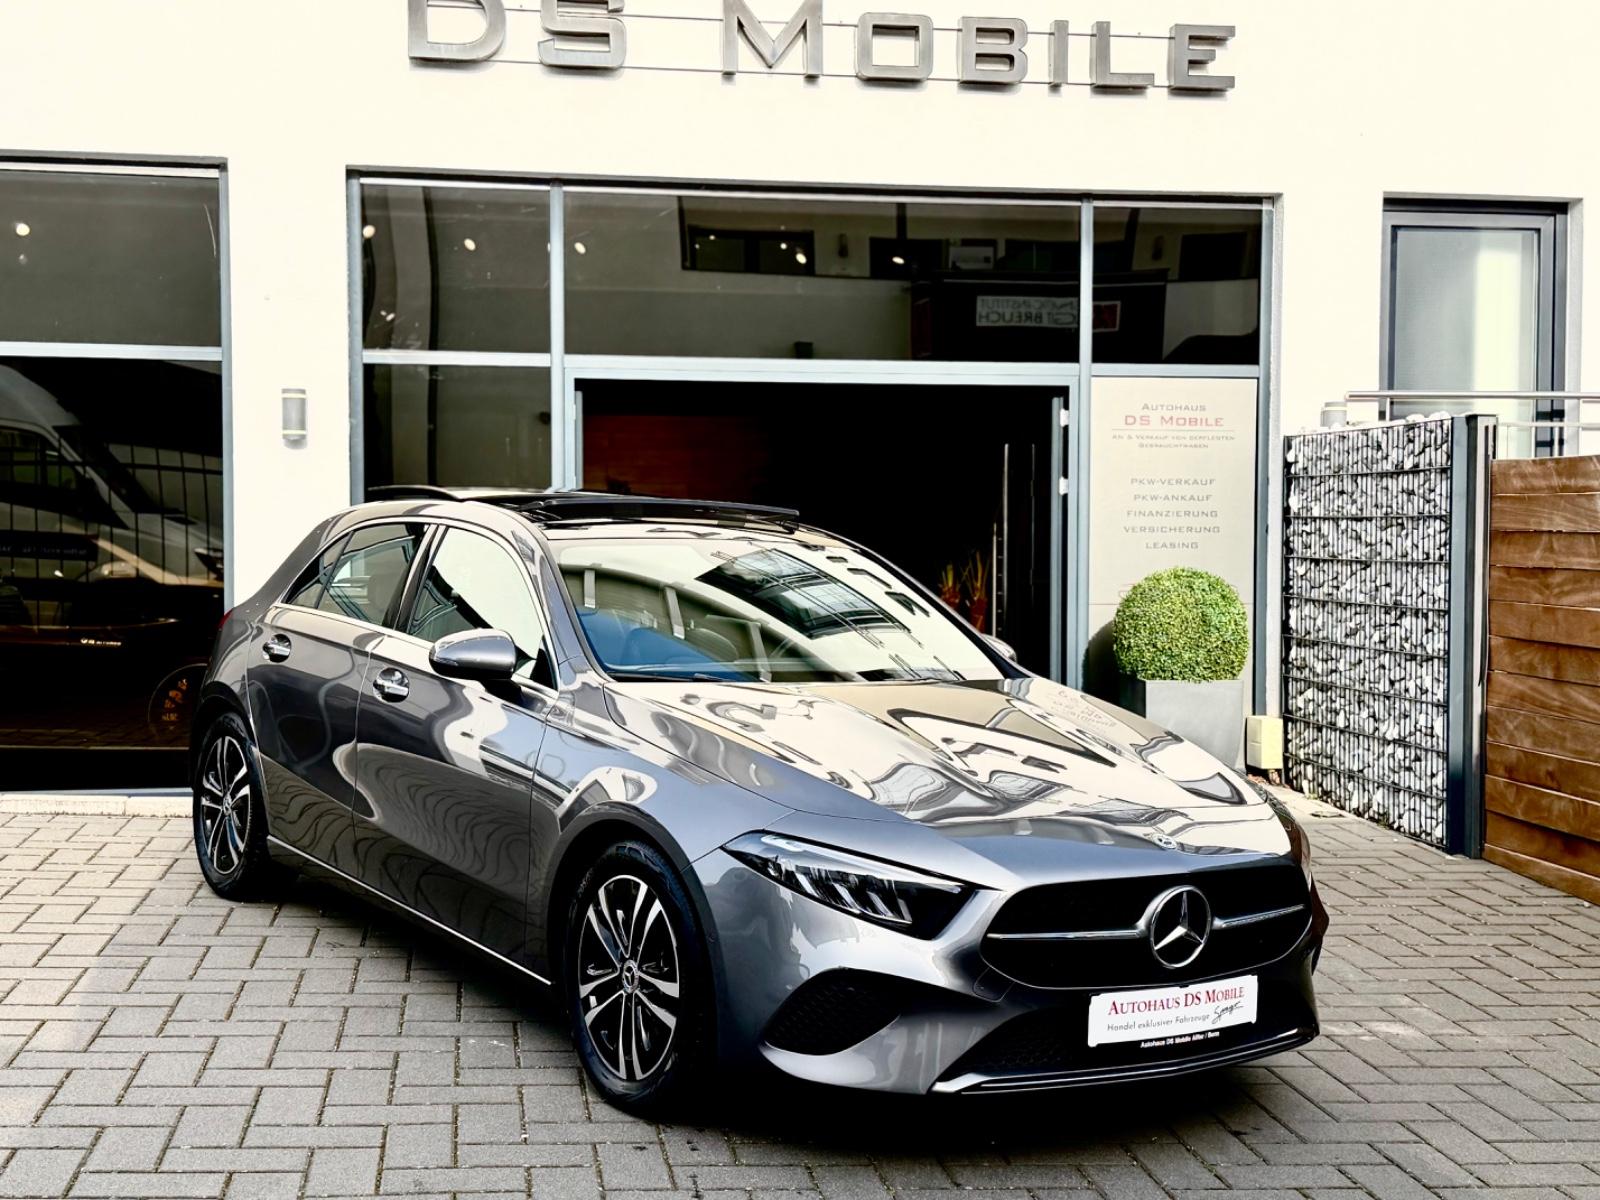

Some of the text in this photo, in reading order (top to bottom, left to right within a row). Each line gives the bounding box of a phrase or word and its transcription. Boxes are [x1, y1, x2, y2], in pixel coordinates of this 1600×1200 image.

[408, 0, 1236, 93] DS MOBILE
[1141, 402, 1207, 412] AUTOHAUS
[1124, 415, 1225, 428] DS MOBILE
[1130, 477, 1216, 487] PKW-VERKAUF
[1133, 493, 1213, 503] PKW-ANKAUF
[1126, 509, 1219, 519] FINANZIERUNG
[1123, 525, 1221, 535] VERSICHERUNG
[1145, 541, 1199, 550] LEASING
[1107, 986, 1245, 1016] AUTOHAUS DS MOBILE
[1107, 1013, 1210, 1032] Handel exklusiver Fahrzeuge
[1140, 1039, 1166, 1049] Autohaus
